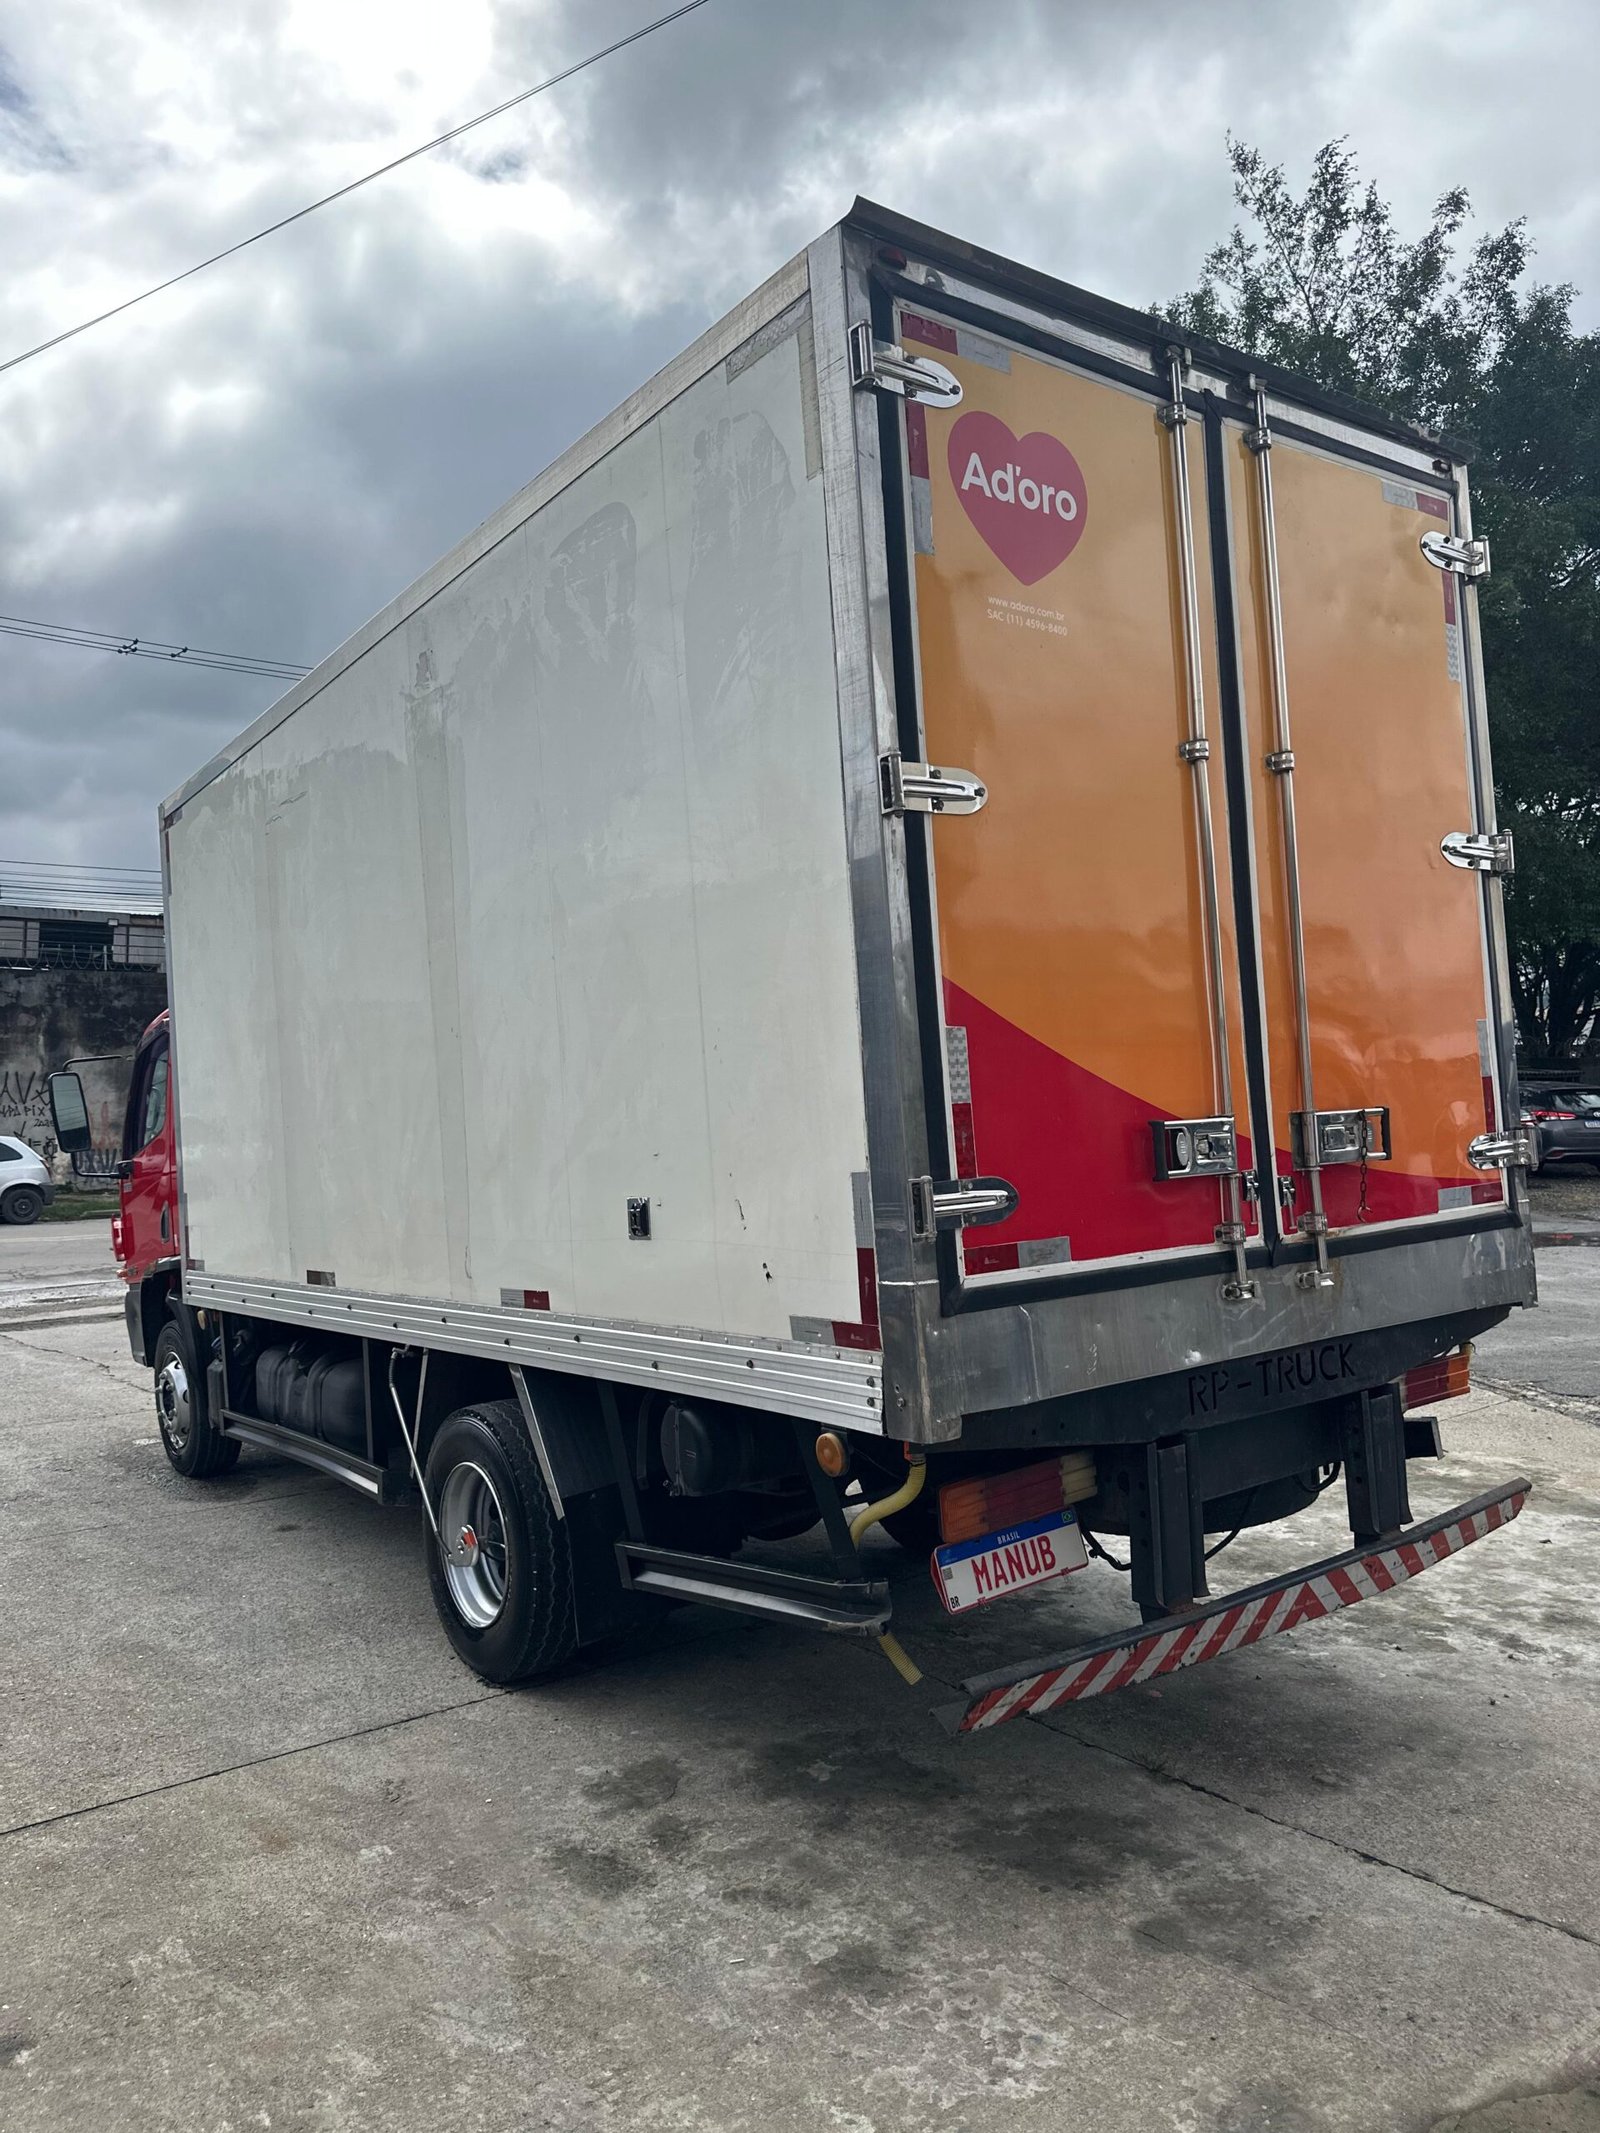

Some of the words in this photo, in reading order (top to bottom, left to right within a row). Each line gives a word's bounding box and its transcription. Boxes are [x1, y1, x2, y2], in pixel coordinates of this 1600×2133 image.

[961, 452, 1077, 521] Ad'oro
[987, 596, 1065, 621] www.adoro.com.br
[987, 608, 1004, 621] SAC
[1006, 613, 1023, 627] (11)
[1025, 618, 1068, 636] 4596-8400
[997, 1531, 1020, 1545] BRASIL
[971, 1535, 1056, 1594] MANUB
[949, 1596, 961, 1609] BR
